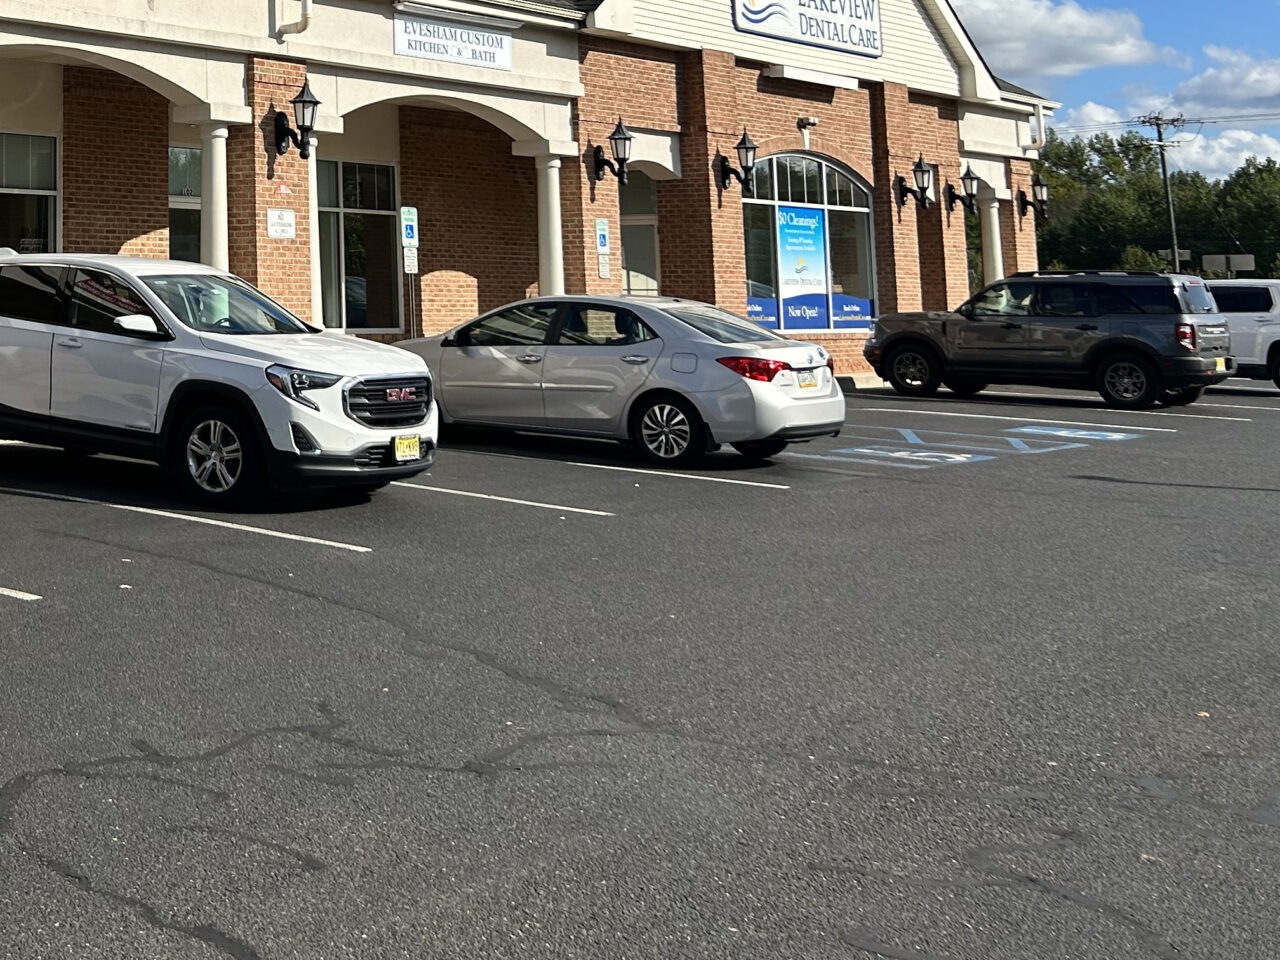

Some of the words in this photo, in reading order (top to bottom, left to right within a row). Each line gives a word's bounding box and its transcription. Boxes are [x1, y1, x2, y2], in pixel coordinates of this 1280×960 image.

[404, 21, 458, 42] EVESHAM
[460, 30, 504, 49] CUSTOM
[407, 39, 449, 55] KITCHEN
[471, 48, 496, 63] BATH
[788, 305, 801, 317] Now
[801, 305, 819, 320] Open!
[386, 387, 417, 401] GMC
